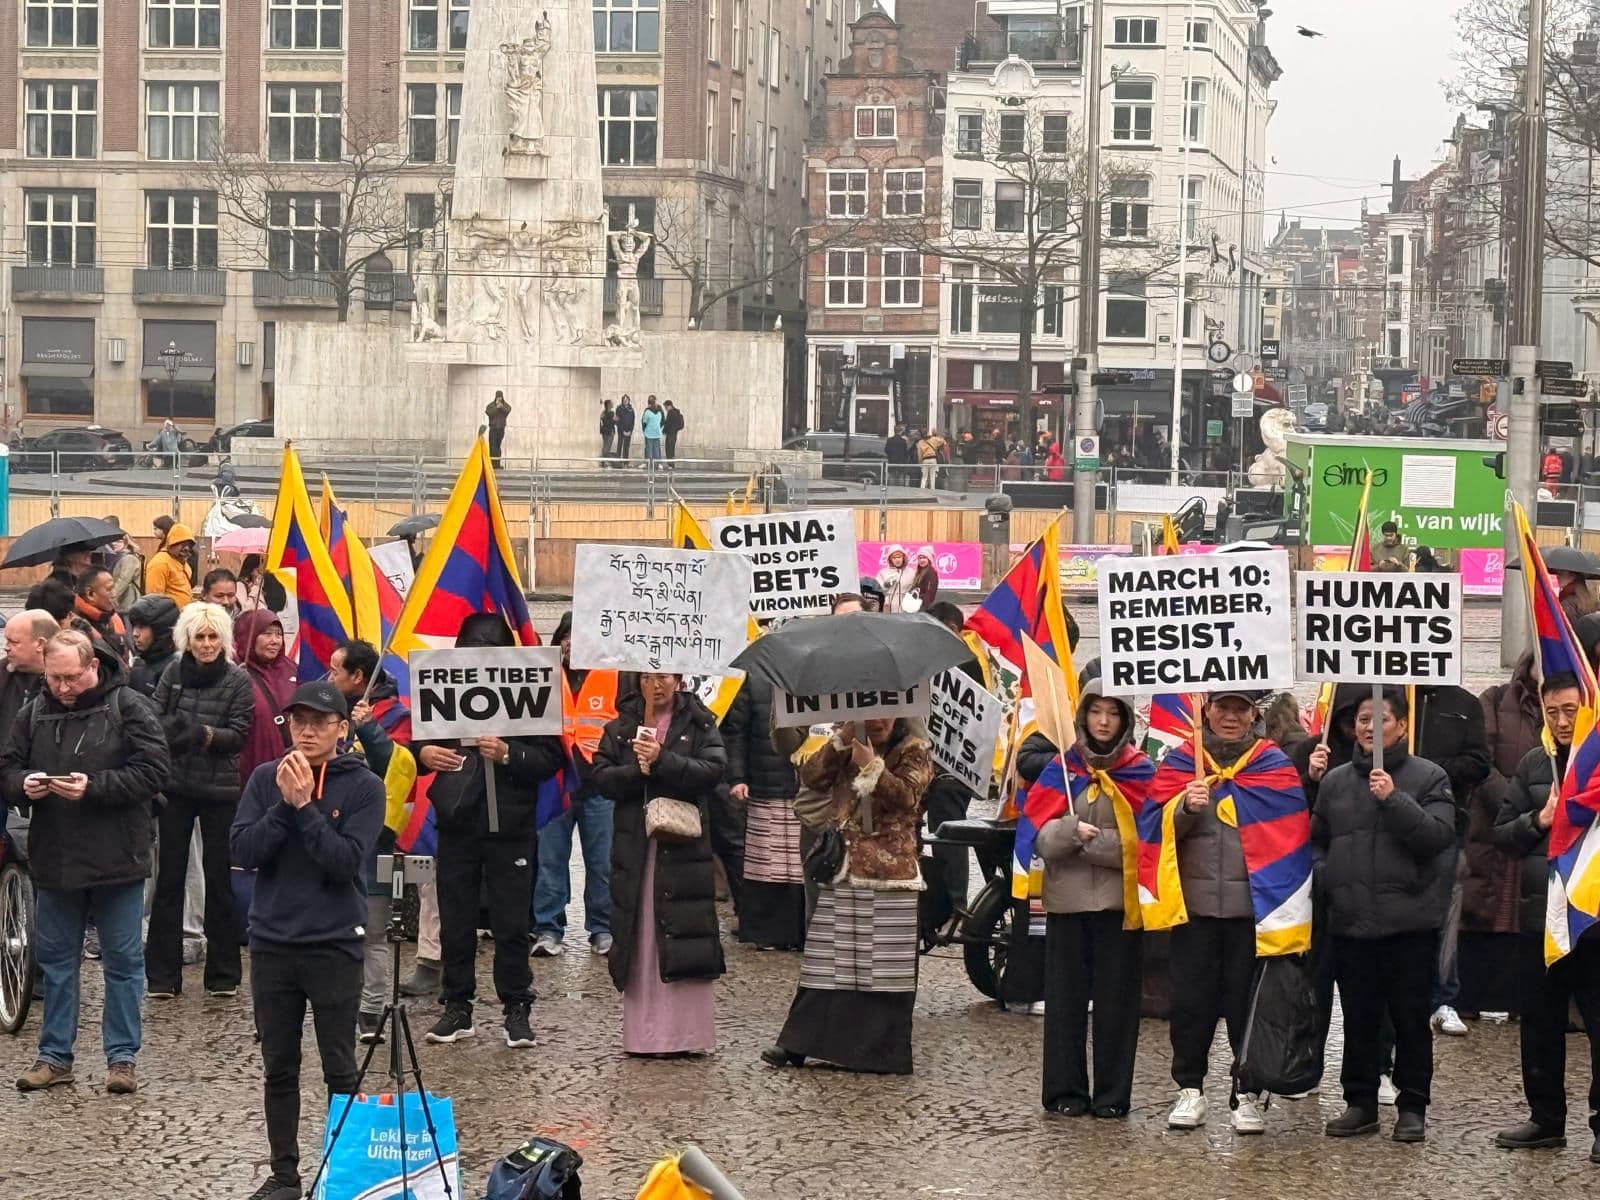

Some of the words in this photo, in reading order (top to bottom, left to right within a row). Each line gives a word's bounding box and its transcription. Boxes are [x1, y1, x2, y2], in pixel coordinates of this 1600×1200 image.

[720, 519, 835, 549] CHINA:
[1416, 514, 1453, 530] van
[1460, 512, 1502, 536] wijk
[1401, 534, 1417, 545] fra
[786, 549, 819, 563] OFF
[752, 566, 840, 593] BET'S
[1109, 567, 1219, 593] MARCH
[1229, 565, 1270, 587] 10:
[1110, 593, 1272, 620] REMEMBER,
[1306, 580, 1450, 610] HUMAN
[1111, 622, 1243, 653] RESIST,
[1306, 613, 1453, 645] RIGHTS
[418, 668, 478, 685] FREE
[485, 666, 553, 684] TIBET
[1112, 655, 1269, 686] RECLAIM
[1306, 648, 1341, 674] IN
[1352, 650, 1453, 677] TIBET
[419, 686, 553, 722] NOW
[785, 691, 820, 714] IN
[933, 669, 984, 721] INA:
[942, 702, 969, 727] OFF
[928, 712, 977, 764] ET'S
